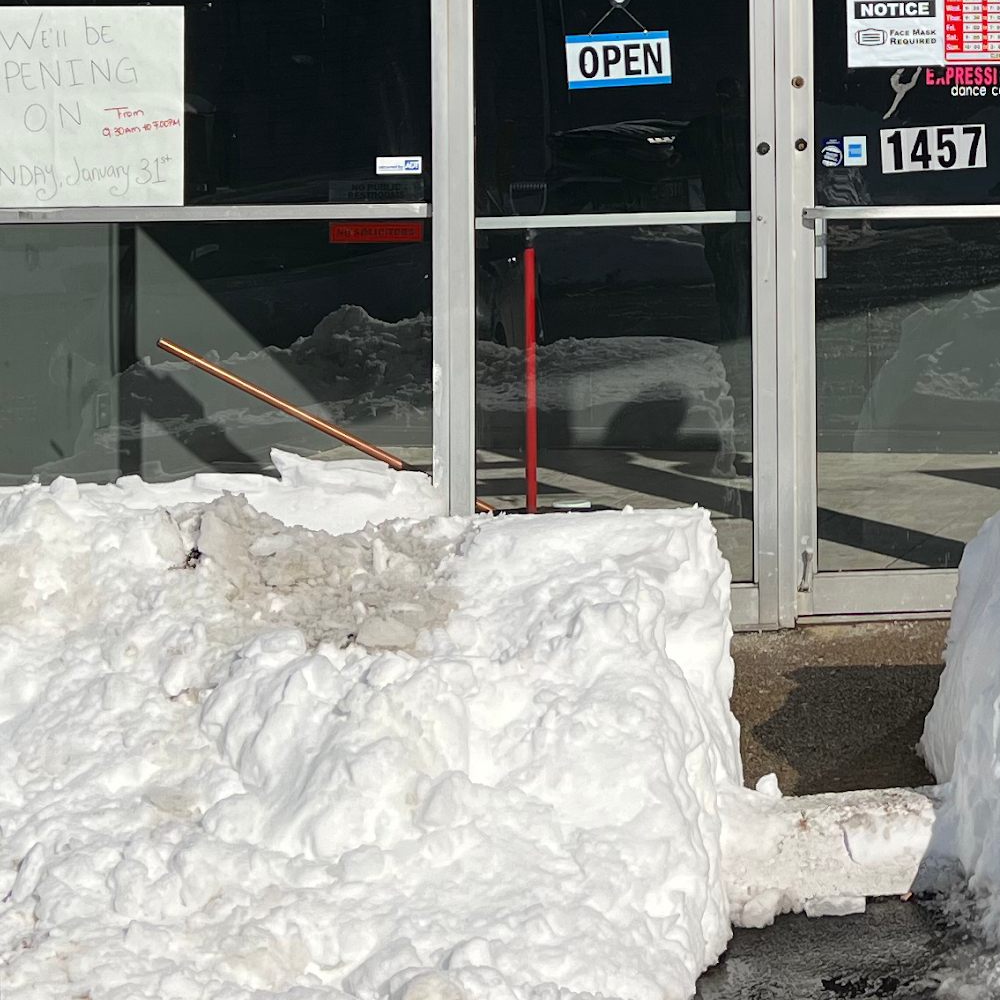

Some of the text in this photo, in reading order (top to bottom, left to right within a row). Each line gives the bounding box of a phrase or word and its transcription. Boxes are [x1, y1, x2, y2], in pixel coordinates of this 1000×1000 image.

[860, 2, 930, 17] NOTICE
[912, 28, 937, 36] MASK
[890, 37, 937, 45] REQUIRED
[579, 42, 663, 79] OPEN
[4, 56, 138, 93] PENING
[950, 84, 987, 97] dance
[24, 101, 82, 133] ON
[103, 106, 145, 119] From
[886, 126, 983, 171] 1457
[0, 154, 172, 201] NDAY, January 31st
[352, 183, 401, 191] NO PUBLIC
[348, 191, 405, 199] RESTROOMS
